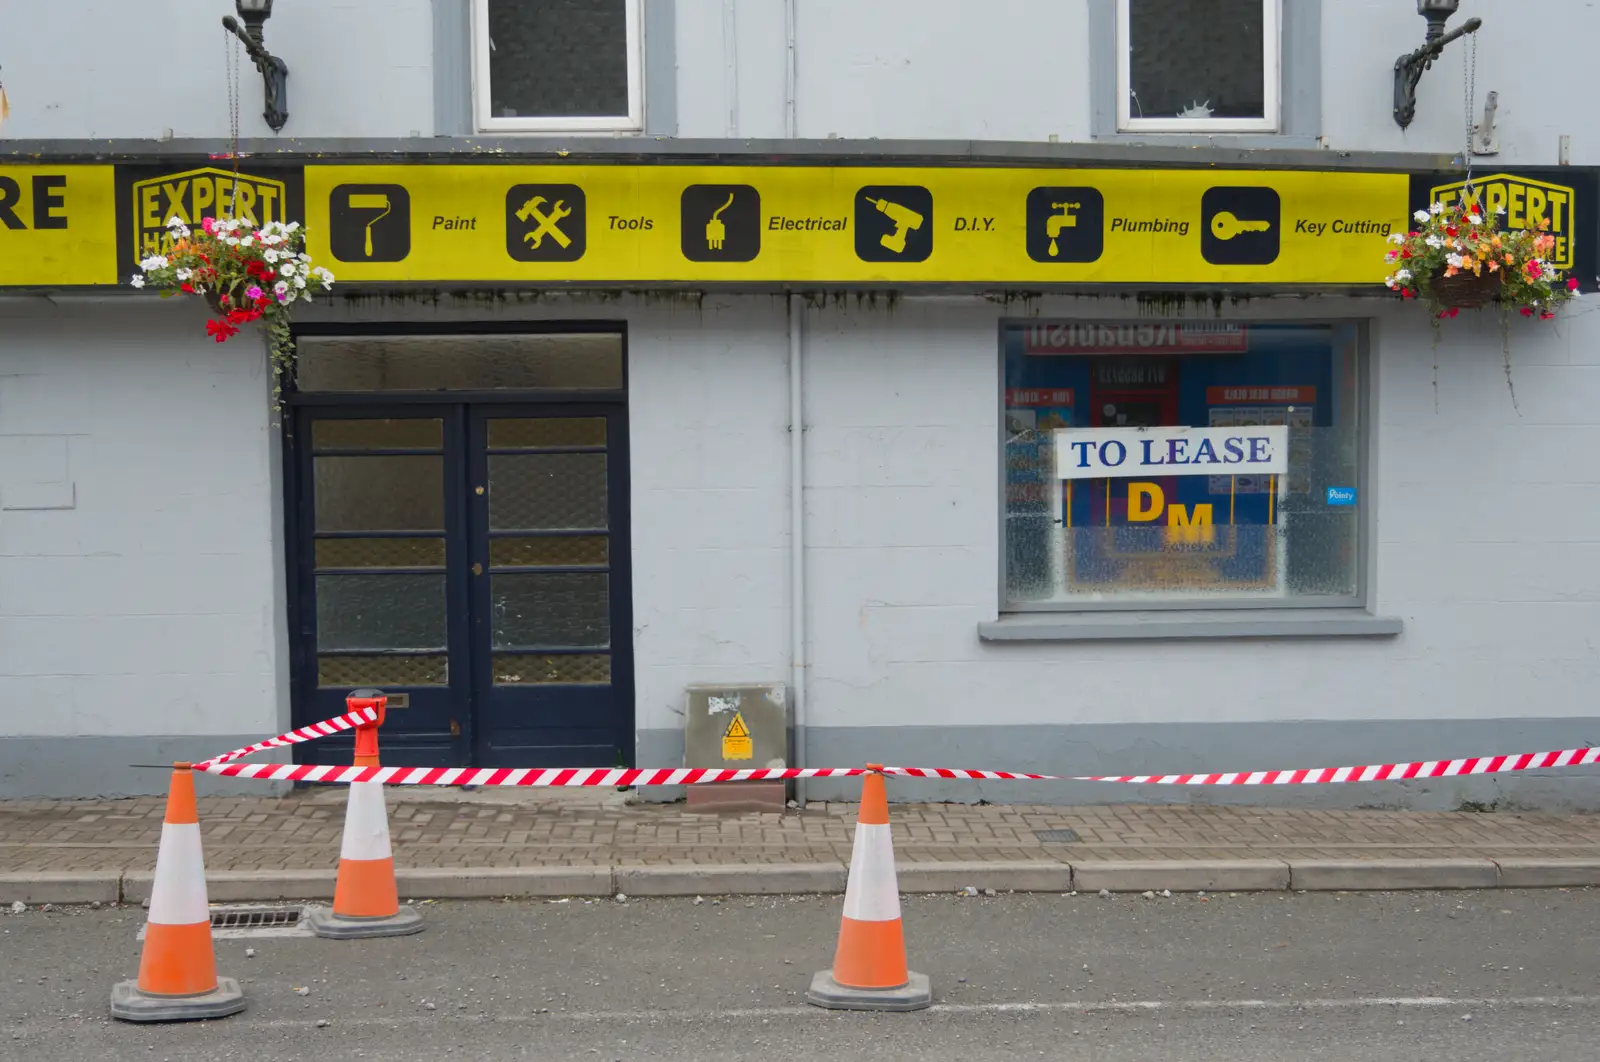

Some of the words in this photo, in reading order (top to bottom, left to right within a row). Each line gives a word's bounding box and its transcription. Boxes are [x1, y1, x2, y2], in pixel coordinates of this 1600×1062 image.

[142, 176, 278, 229] EXPERT
[432, 215, 477, 230] Paint
[608, 215, 654, 230] Tools
[768, 216, 848, 231] Electrical
[954, 217, 996, 231] D.I.Y.
[1110, 217, 1190, 236] Plumbing
[1294, 219, 1327, 237] Key
[1331, 219, 1392, 237] Cutting
[1071, 439, 1127, 468] TO
[1139, 437, 1273, 465] LEASE
[1329, 488, 1354, 501] Pointy
